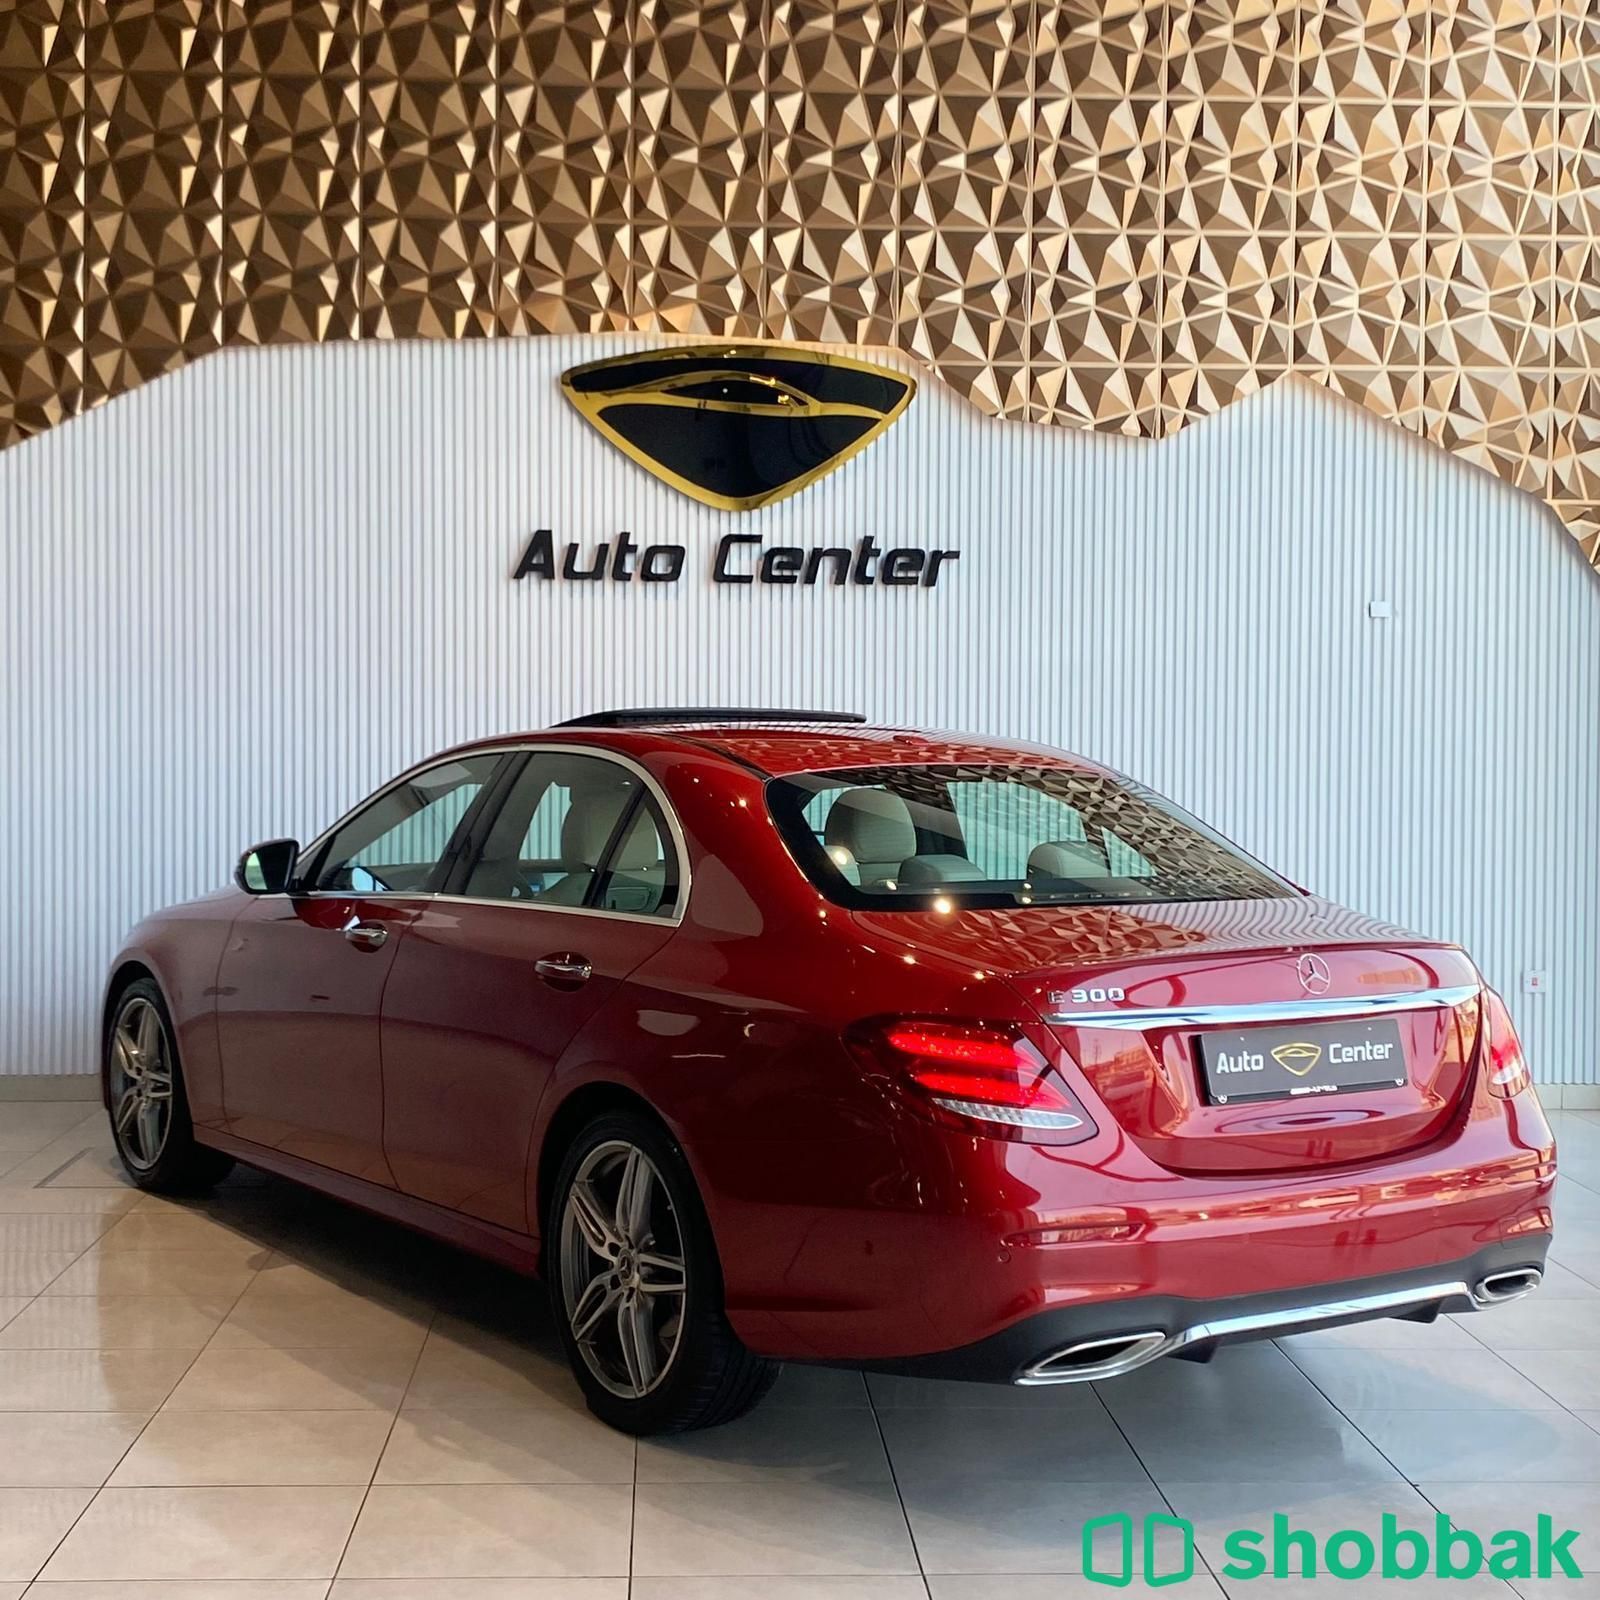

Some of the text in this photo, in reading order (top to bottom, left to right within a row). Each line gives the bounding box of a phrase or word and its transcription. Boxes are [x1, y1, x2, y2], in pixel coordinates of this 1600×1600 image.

[513, 529, 960, 587] Auto Center
[1047, 987, 1125, 1004] E 300
[1216, 1040, 1393, 1074] Auto Center
